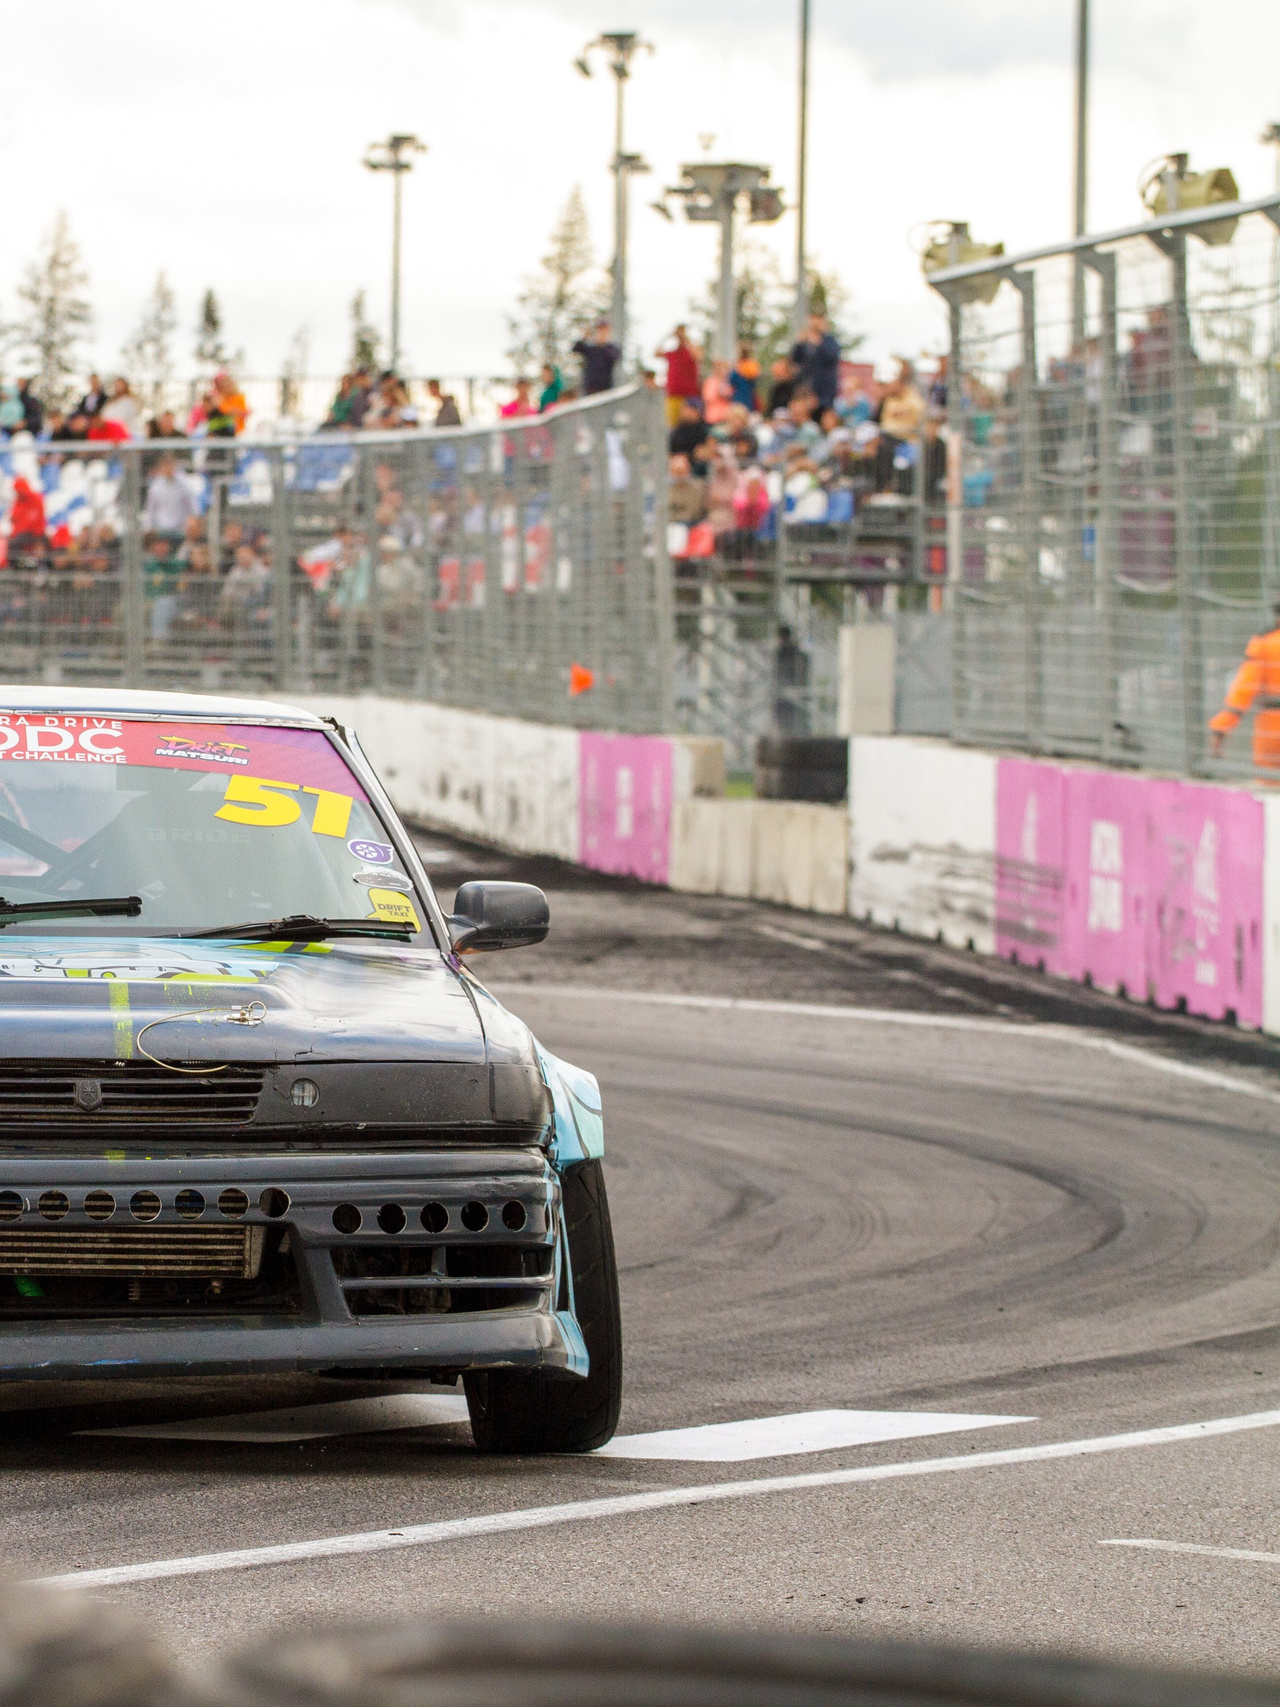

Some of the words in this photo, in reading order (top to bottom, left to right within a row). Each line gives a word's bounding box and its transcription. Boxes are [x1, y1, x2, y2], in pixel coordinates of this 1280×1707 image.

[45, 717, 123, 730] DRIVE
[11, 751, 127, 764] CHALLENGE
[155, 748, 249, 765] MATSURI
[214, 774, 354, 839] 51
[377, 903, 411, 913] DRIFT
